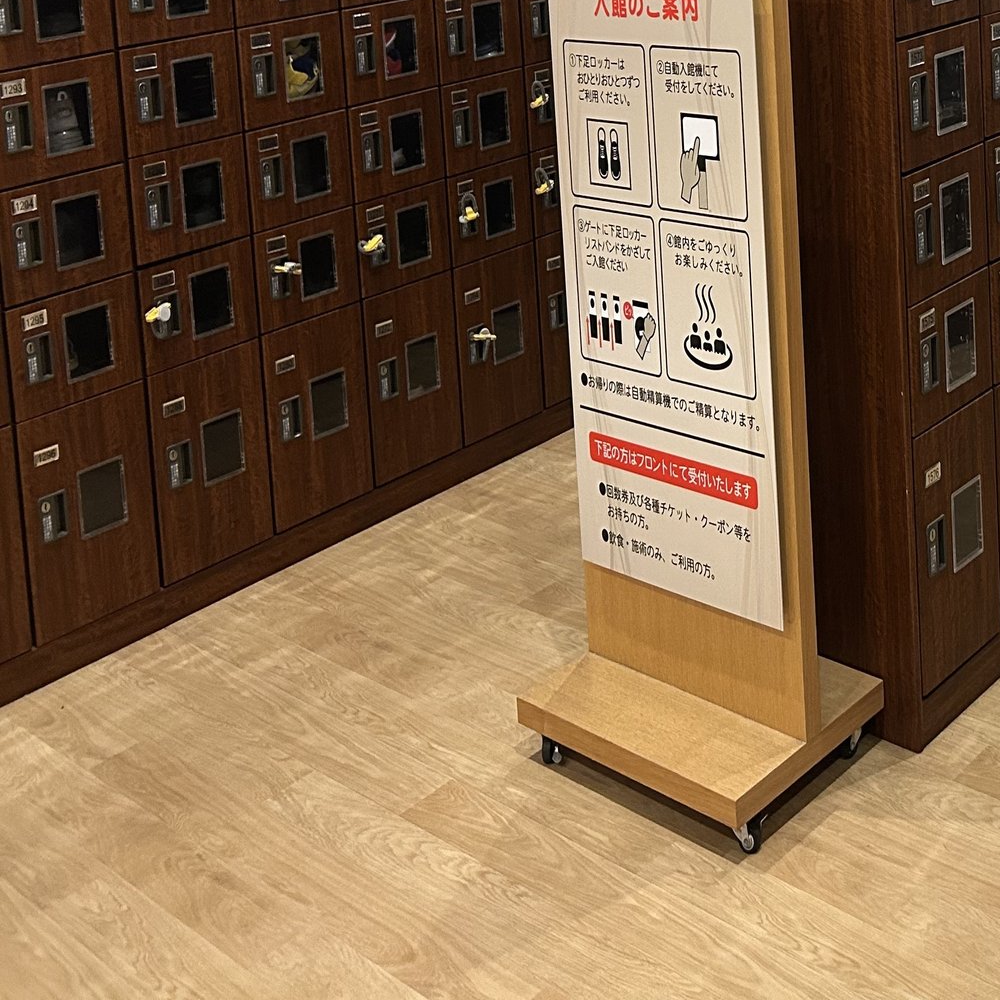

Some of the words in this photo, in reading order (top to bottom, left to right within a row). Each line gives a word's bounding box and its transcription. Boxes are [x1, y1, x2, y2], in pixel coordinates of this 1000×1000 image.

[4, 83, 23, 95] 1293
[577, 71, 641, 89] おひとりおひとつずつ
[665, 78, 735, 99] 受付をしてください。
[578, 88, 631, 107] ご利用ください。
[584, 236, 651, 261] リストバンドをかざして
[586, 253, 628, 273] ご入館ください
[674, 252, 744, 278] お楽しみください。
[26, 313, 45, 327] 1295
[594, 438, 752, 500] 下記の方はフロントにて受付いたします
[607, 504, 650, 531] お持ちの方。
